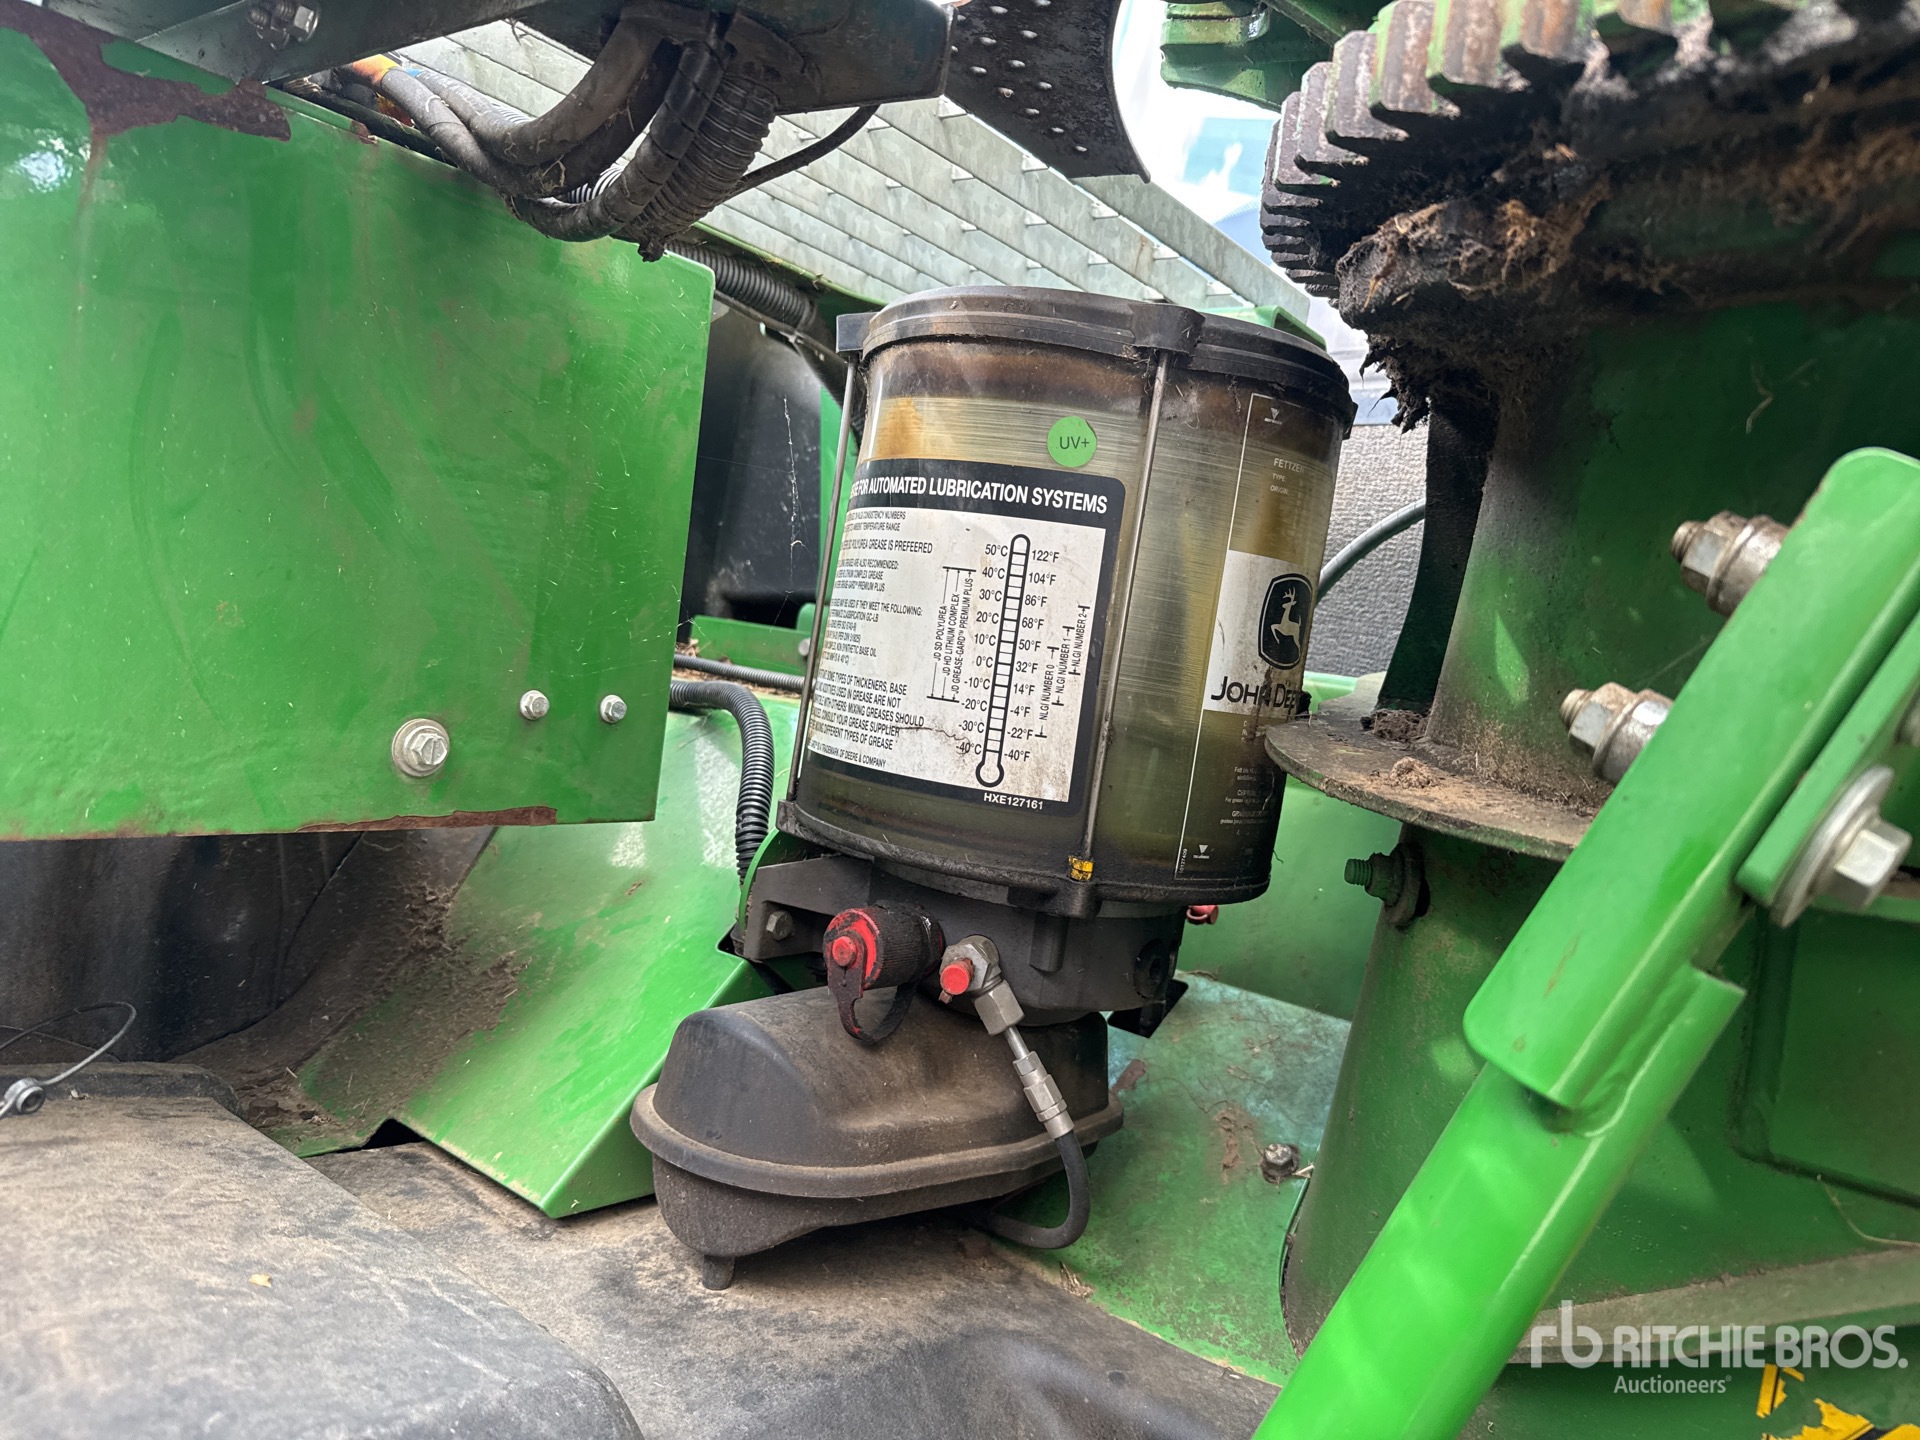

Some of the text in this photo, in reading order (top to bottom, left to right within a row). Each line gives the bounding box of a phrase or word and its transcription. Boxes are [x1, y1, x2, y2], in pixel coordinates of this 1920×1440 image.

[1059, 436, 1090, 450] UV+
[858, 479, 869, 496] FOR
[869, 476, 926, 495] AUTOMATED
[929, 477, 1028, 504] LUBRICATION
[1031, 487, 1108, 514] SYSTEMS
[885, 511, 906, 520] NUMBERS
[886, 523, 901, 531] RANGE
[869, 539, 887, 551] GREASE
[887, 540, 894, 551] IS
[894, 540, 933, 554] PREFEERED
[985, 544, 1009, 557] 50°C
[1032, 549, 1060, 563] 122°F
[867, 559, 899, 570] RECOMMENDED:
[868, 570, 884, 580] GREASE
[982, 566, 1006, 580] 40°C
[1029, 572, 1057, 586] 104°F
[874, 582, 886, 592] PLUS
[964, 578, 974, 598] PLUS
[979, 588, 1003, 602] 30°C
[1024, 594, 1048, 607] 86°F
[860, 600, 868, 610] THEY
[869, 601, 880, 611] MEET
[881, 603, 890, 612] THE
[890, 603, 924, 616] FOLLOWING:
[959, 598, 971, 629] PREMIUM
[866, 612, 879, 622] GC-LB
[976, 611, 1000, 624] 20°C
[1021, 617, 1045, 630] 68°F
[933, 605, 948, 662] JD SD POLYUREA
[943, 594, 960, 676] JD HD LITHIUM COMPLEX
[974, 633, 997, 646] 10°C
[1073, 619, 1086, 651] NUMBER
[859, 646, 870, 656] BASE
[1018, 639, 1042, 652] 50°F
[975, 655, 994, 669] 0°C
[1058, 643, 1070, 676] NUMBER
[1071, 651, 1082, 667] NLGI
[1015, 660, 1039, 674] 32°F
[836, 671, 847, 685] TYPES
[847, 675, 853, 686] OF
[853, 676, 888, 694] THICKENERS,
[889, 682, 908, 696] BASE
[951, 683, 960, 694] JD
[963, 677, 991, 690] -10°C
[1013, 683, 1036, 696] 14°F
[1041, 670, 1054, 703] NUMBER
[1055, 676, 1066, 694] NLGI
[853, 690, 873, 704] GREASE
[873, 693, 886, 706] ARE
[886, 696, 901, 709] NOT
[1211, 676, 1296, 709] JOHN DEE
[961, 698, 988, 712] -20°C
[1010, 705, 1031, 718] -4°F
[1039, 703, 1050, 721] NLGI
[847, 702, 865, 716] MIXING
[866, 706, 894, 722] GREASES
[895, 712, 925, 727] SHOULD
[837, 713, 848, 726] YOUR
[848, 716, 869, 731] GREASE
[870, 721, 900, 737] SUPPLIER
[958, 720, 985, 734] -30°C
[844, 728, 859, 743] TYPES
[860, 733, 868, 744] OF
[868, 735, 894, 750] GREASE
[1007, 728, 1034, 741] -22°F
[955, 741, 982, 755] -40°C
[845, 749, 858, 762] DEERE
[862, 754, 887, 768] COMPANY
[1004, 749, 1031, 762] -40°F
[983, 792, 1044, 810] HXE127161
